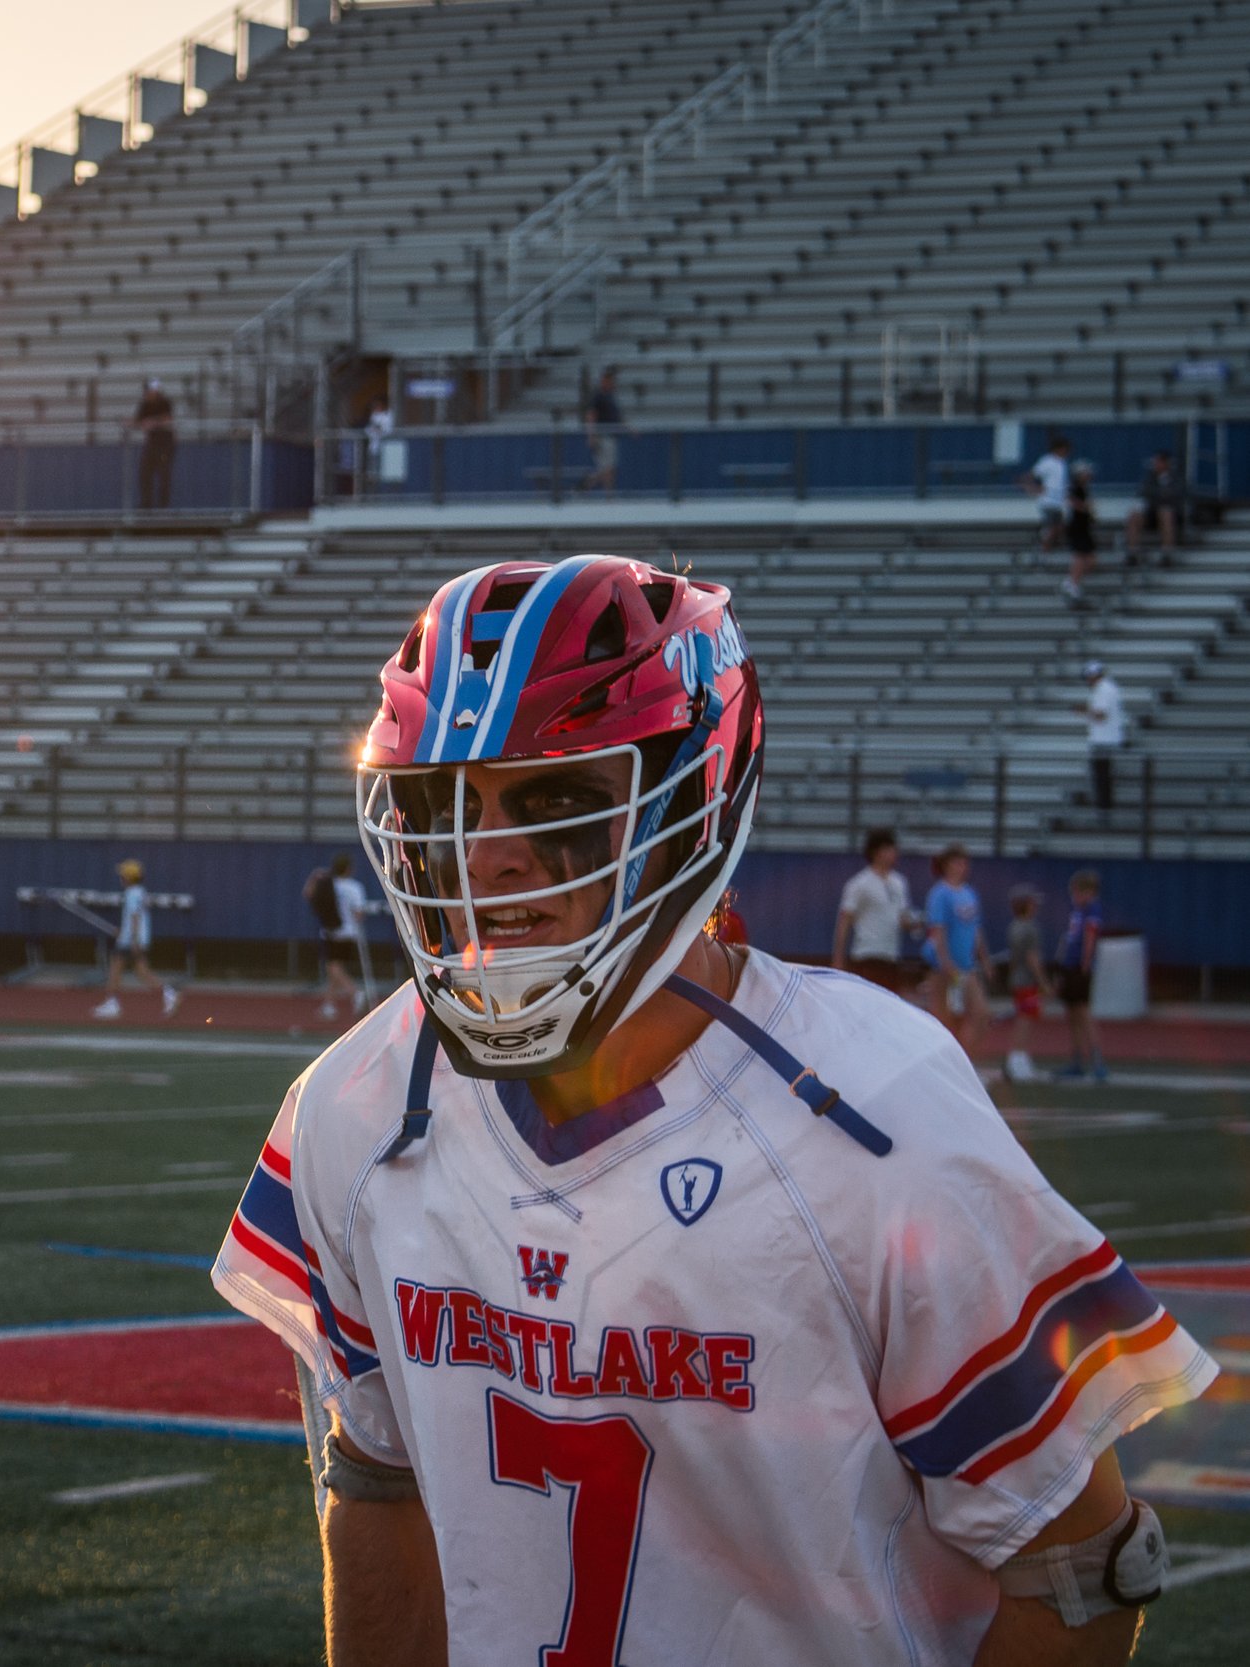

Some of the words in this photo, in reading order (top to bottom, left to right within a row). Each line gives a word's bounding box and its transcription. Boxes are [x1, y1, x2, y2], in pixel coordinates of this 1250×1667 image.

[483, 1046, 548, 1060] cascade
[516, 1243, 569, 1302] W
[395, 1278, 755, 1413] WESTLAKE
[486, 1387, 656, 1667] 7
